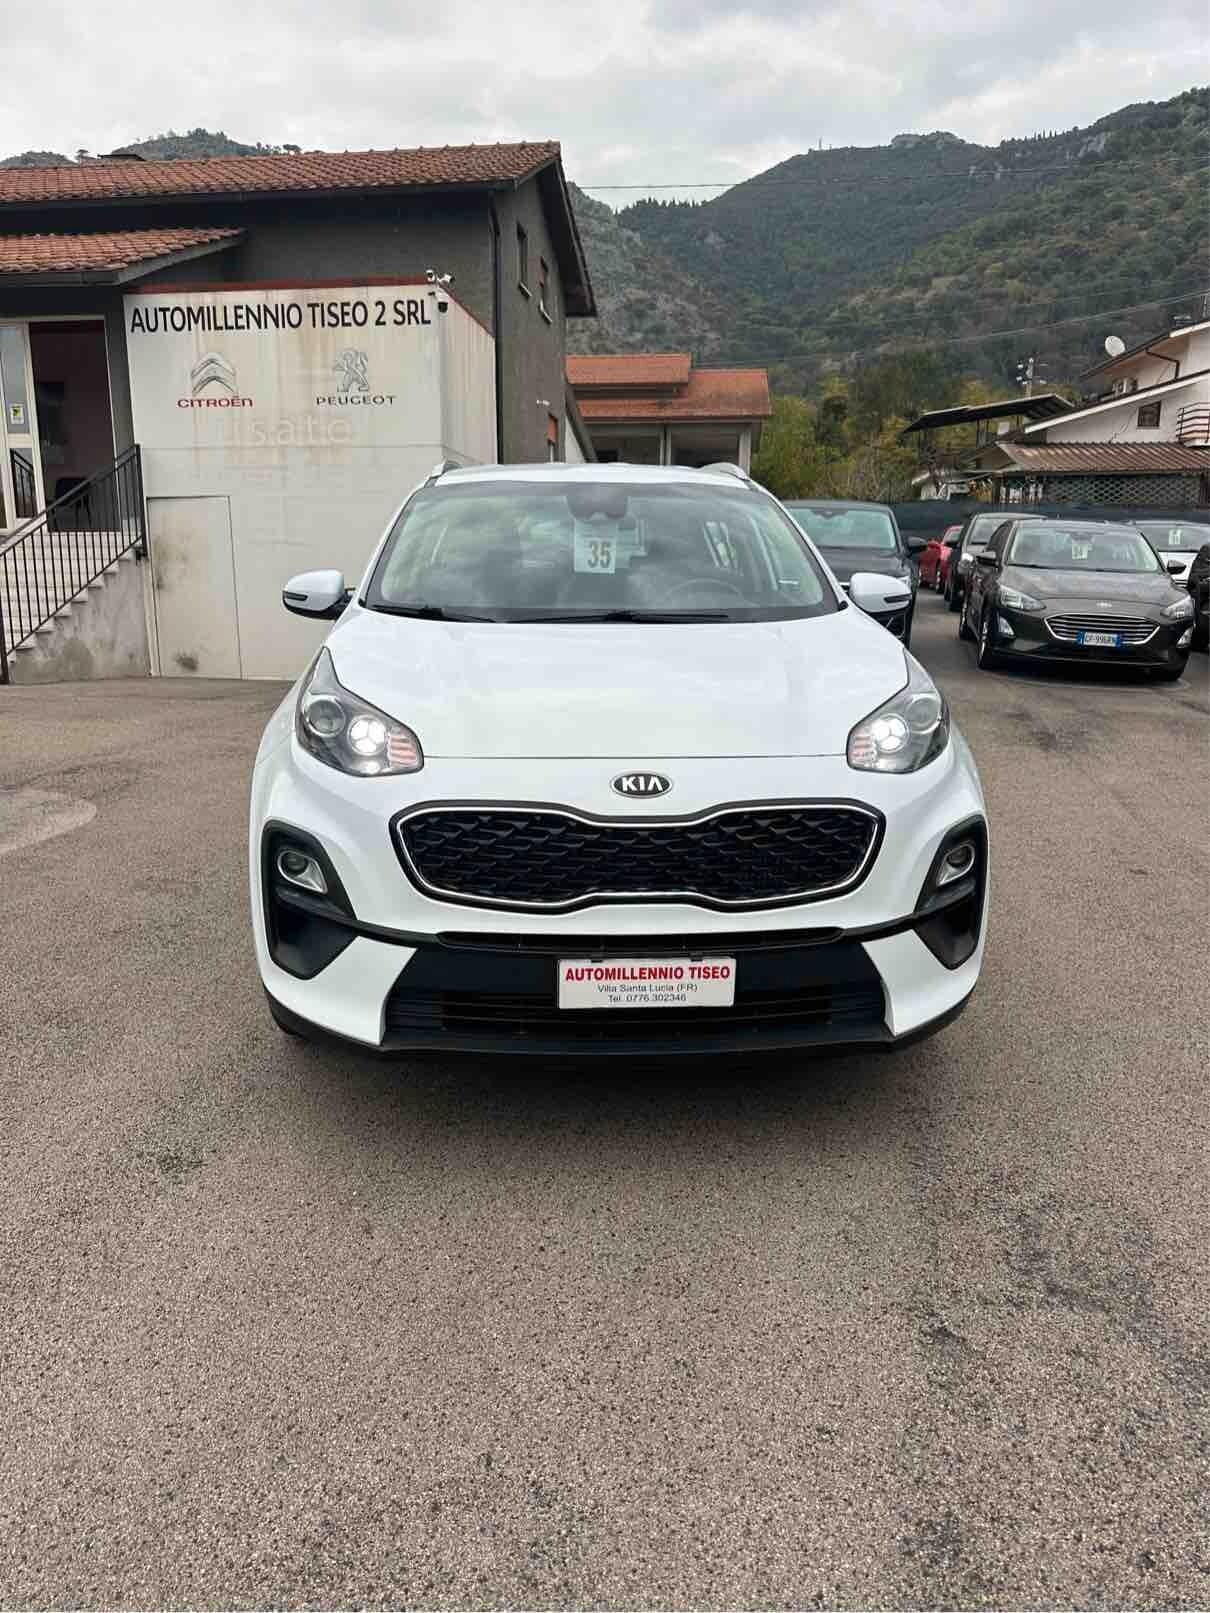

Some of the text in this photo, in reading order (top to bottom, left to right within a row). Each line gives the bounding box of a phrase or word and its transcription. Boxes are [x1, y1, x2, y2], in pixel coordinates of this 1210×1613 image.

[130, 299, 431, 333] AUTOMILLENNIO TISEO 2 SRL
[316, 395, 397, 406] PEUGEOT
[587, 541, 612, 568] 35
[621, 776, 664, 791] KIA
[565, 966, 731, 981] AUTOMILLENNIO TISEO
[620, 984, 647, 993] Santa
[649, 984, 674, 993] Lucia
[676, 983, 698, 992] (FR)
